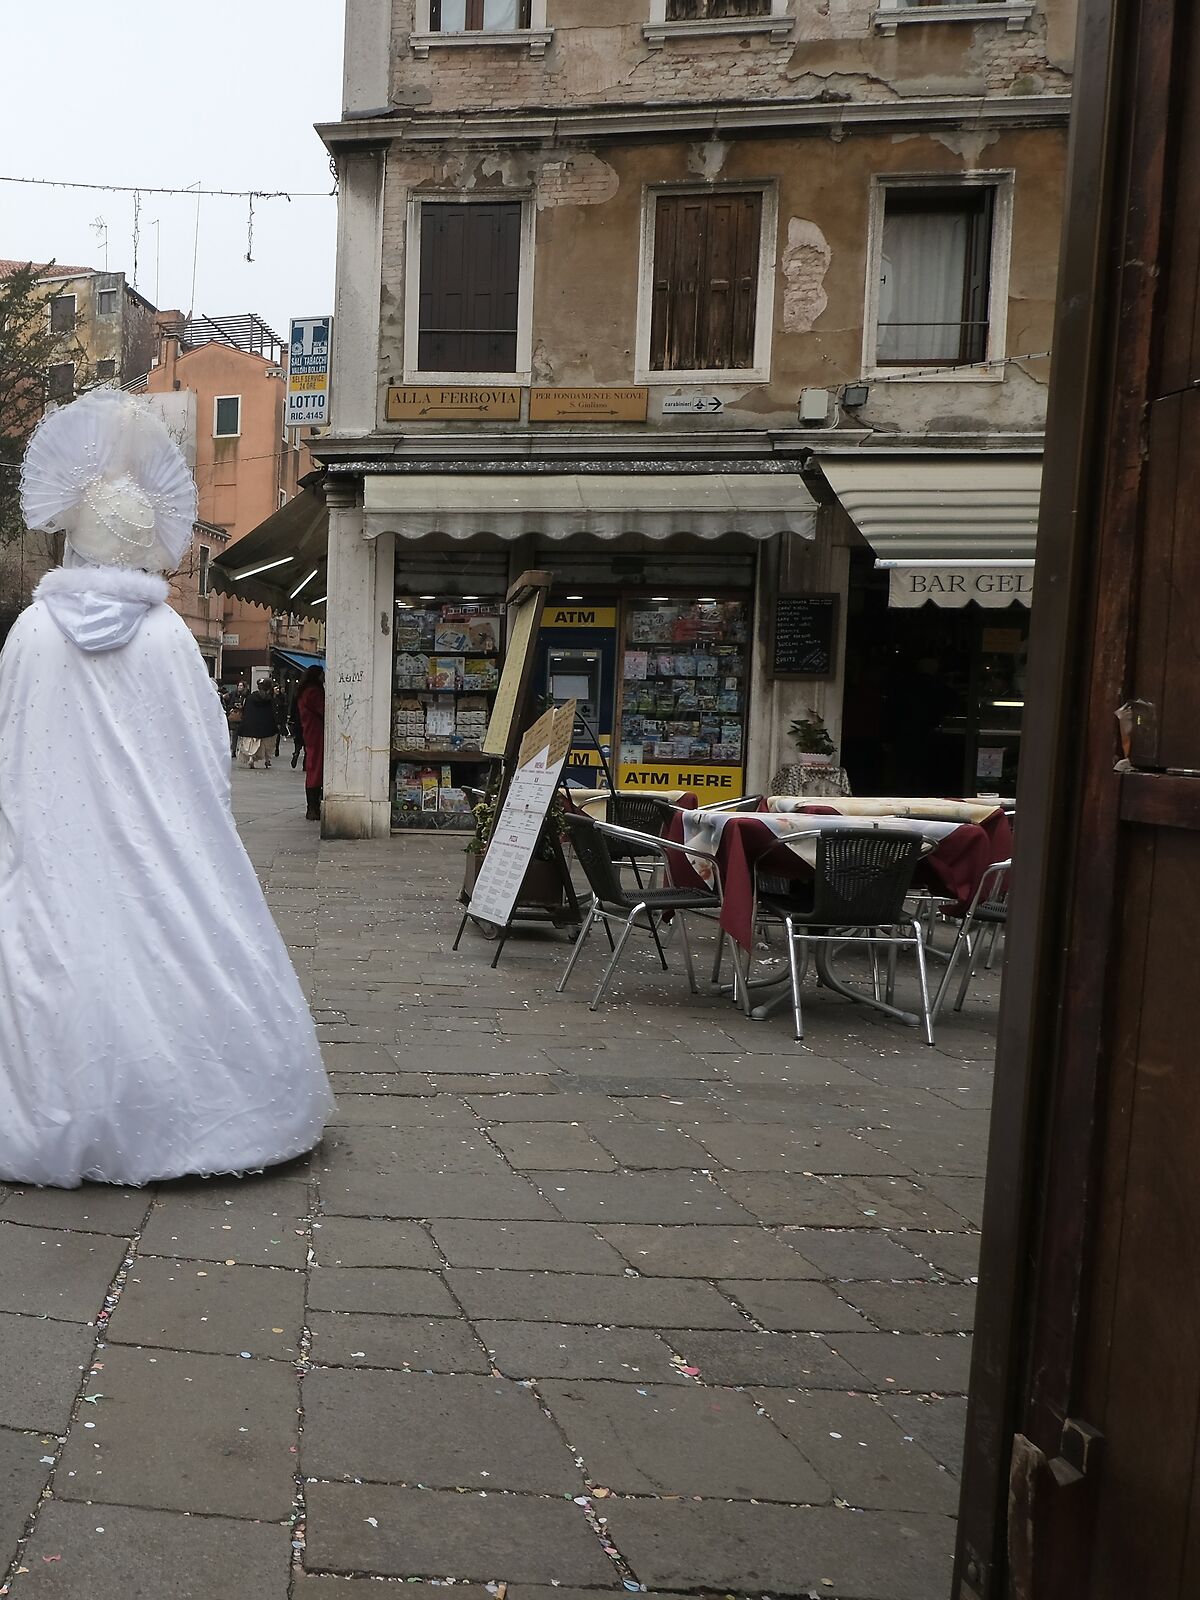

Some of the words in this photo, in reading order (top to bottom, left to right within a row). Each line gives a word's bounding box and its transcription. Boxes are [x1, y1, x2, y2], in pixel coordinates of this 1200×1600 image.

[303, 355, 327, 365] TABACCHI
[289, 394, 325, 408] LOTTO
[392, 392, 431, 404] ALLA
[440, 392, 516, 404] FERROVIA
[553, 392, 610, 400] FONDAMENTE
[614, 392, 644, 400] NUOVE
[290, 411, 324, 420] RIC.4145
[910, 575, 966, 593] BAR
[554, 611, 595, 624] ATM
[567, 753, 590, 765] TM
[625, 771, 673, 786] ATM
[678, 773, 732, 788] HERE
